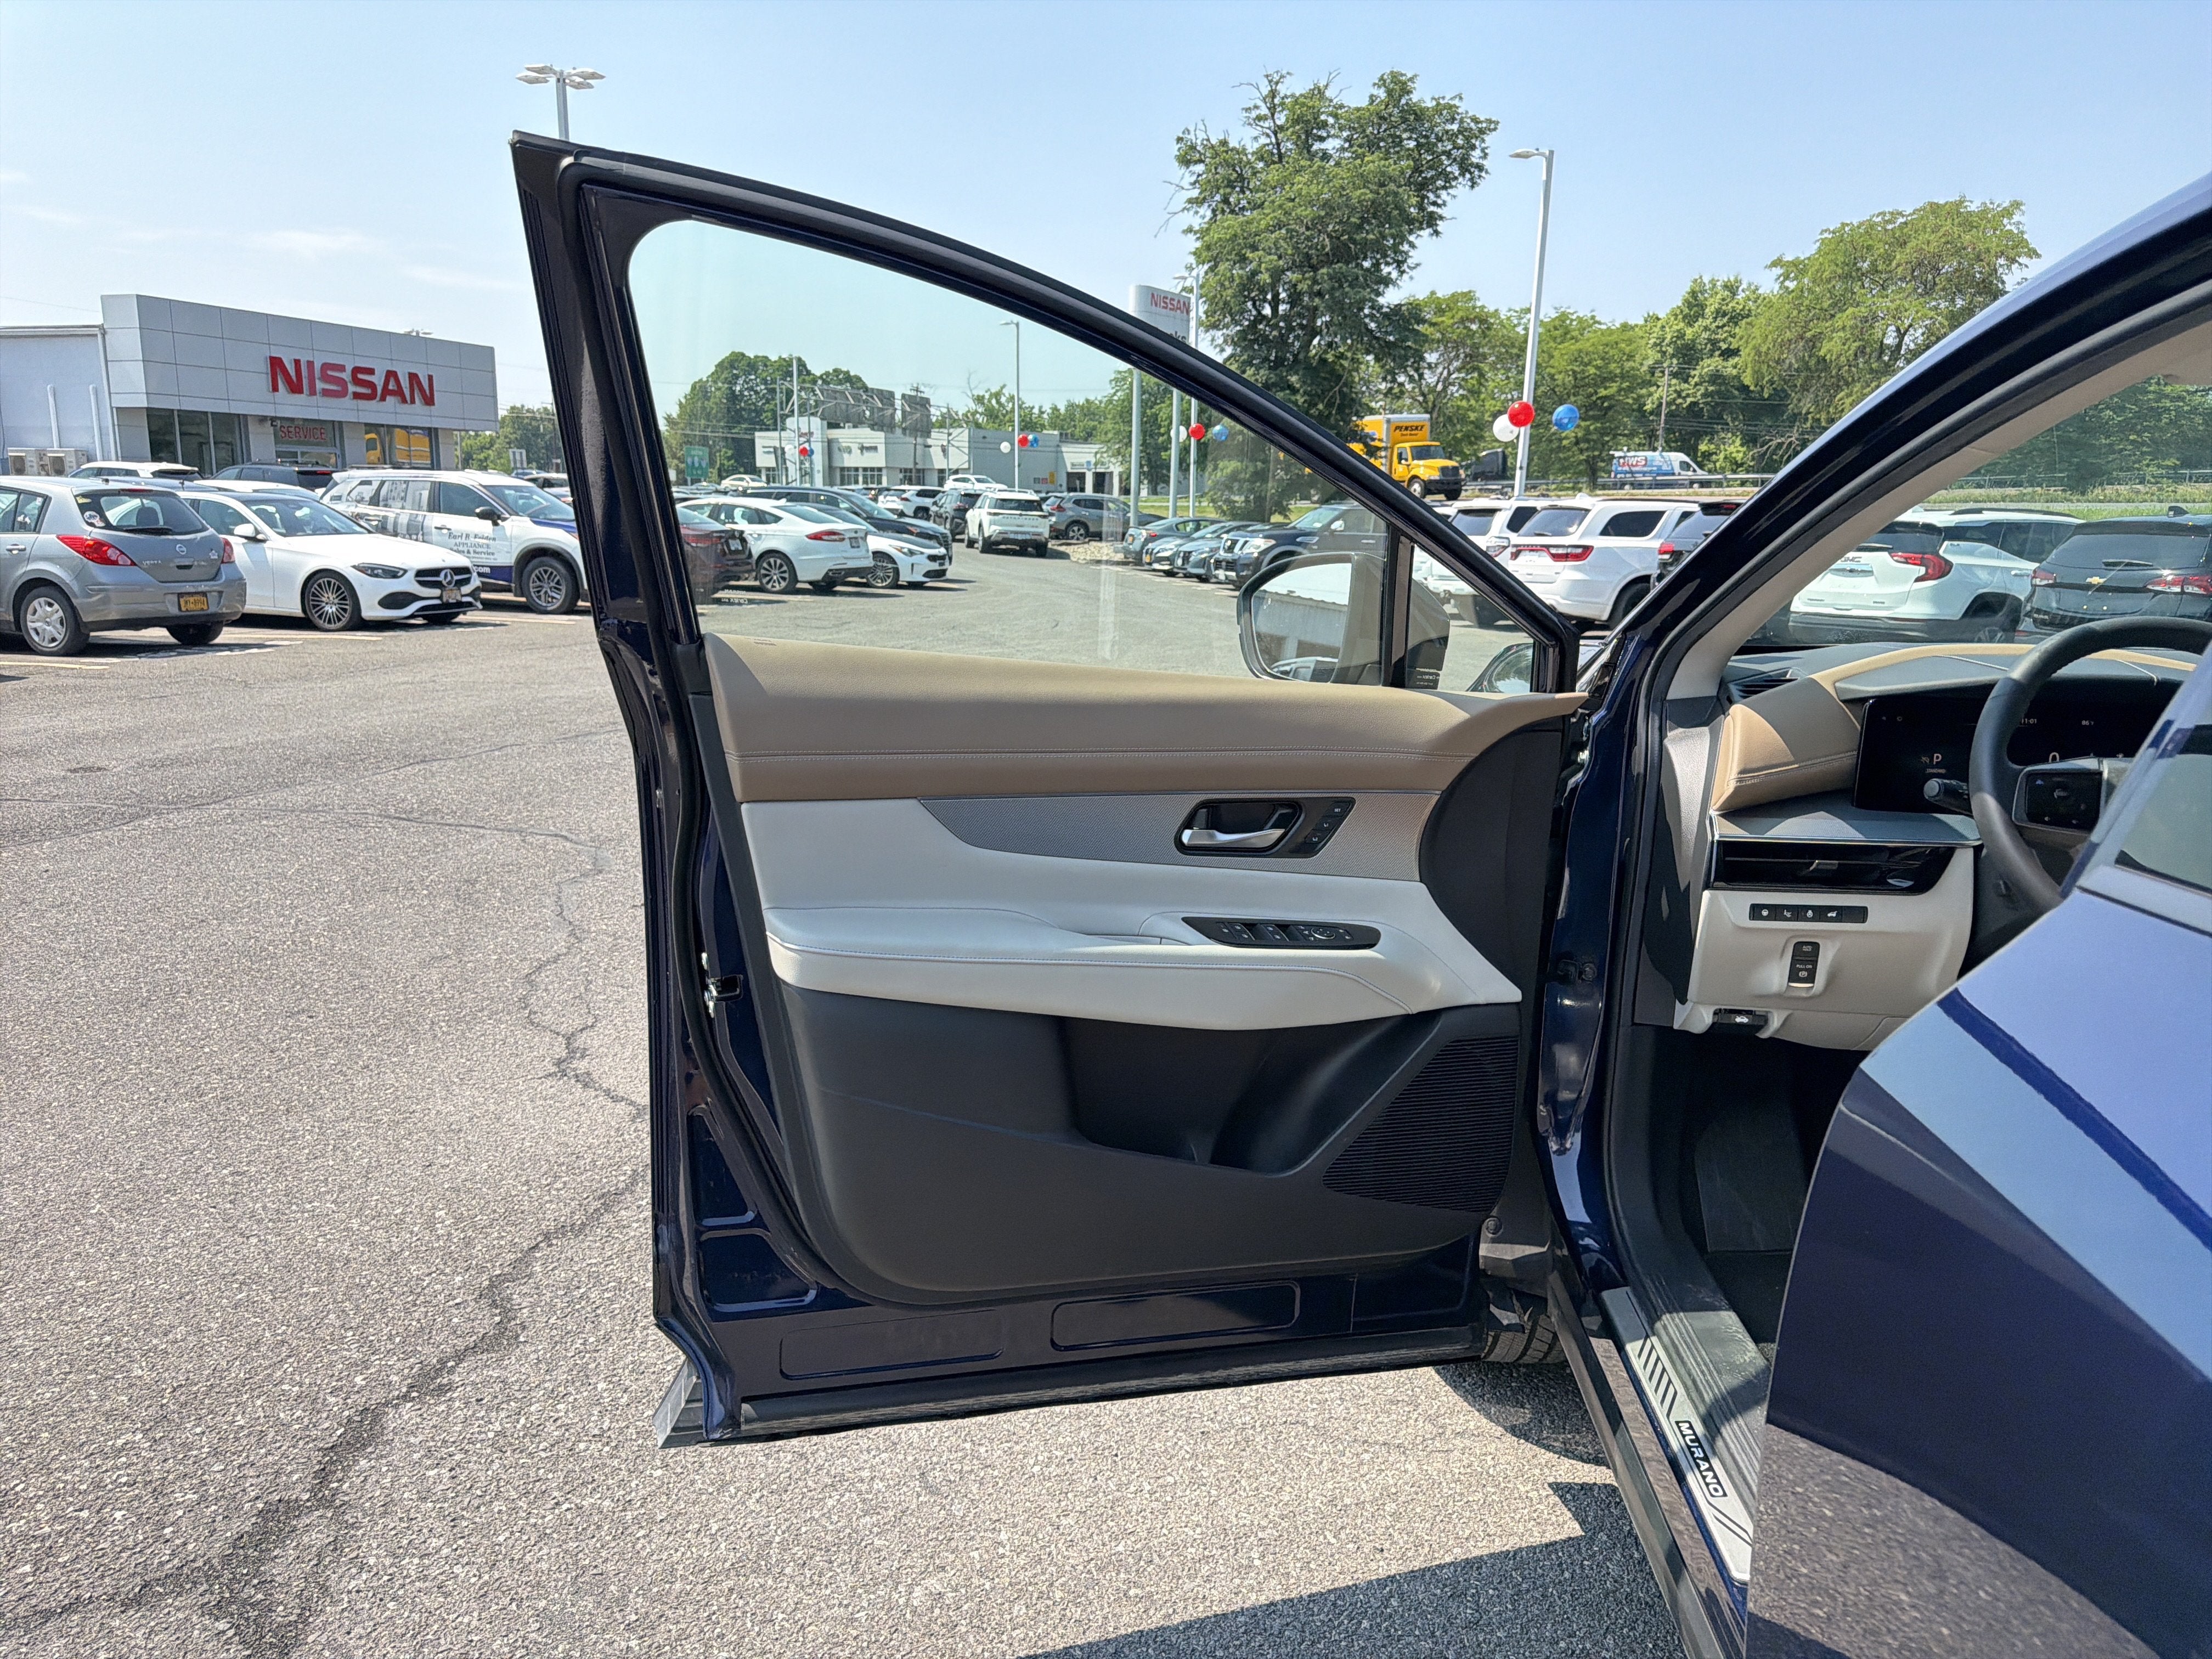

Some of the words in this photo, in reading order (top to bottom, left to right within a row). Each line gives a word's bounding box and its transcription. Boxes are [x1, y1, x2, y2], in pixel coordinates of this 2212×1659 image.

[1150, 292, 1189, 315] NISSAN
[269, 356, 435, 406] NISSAN
[280, 425, 326, 440] SERVICE
[1933, 753, 1942, 765] P
[1679, 1422, 1724, 1496] MURANO
